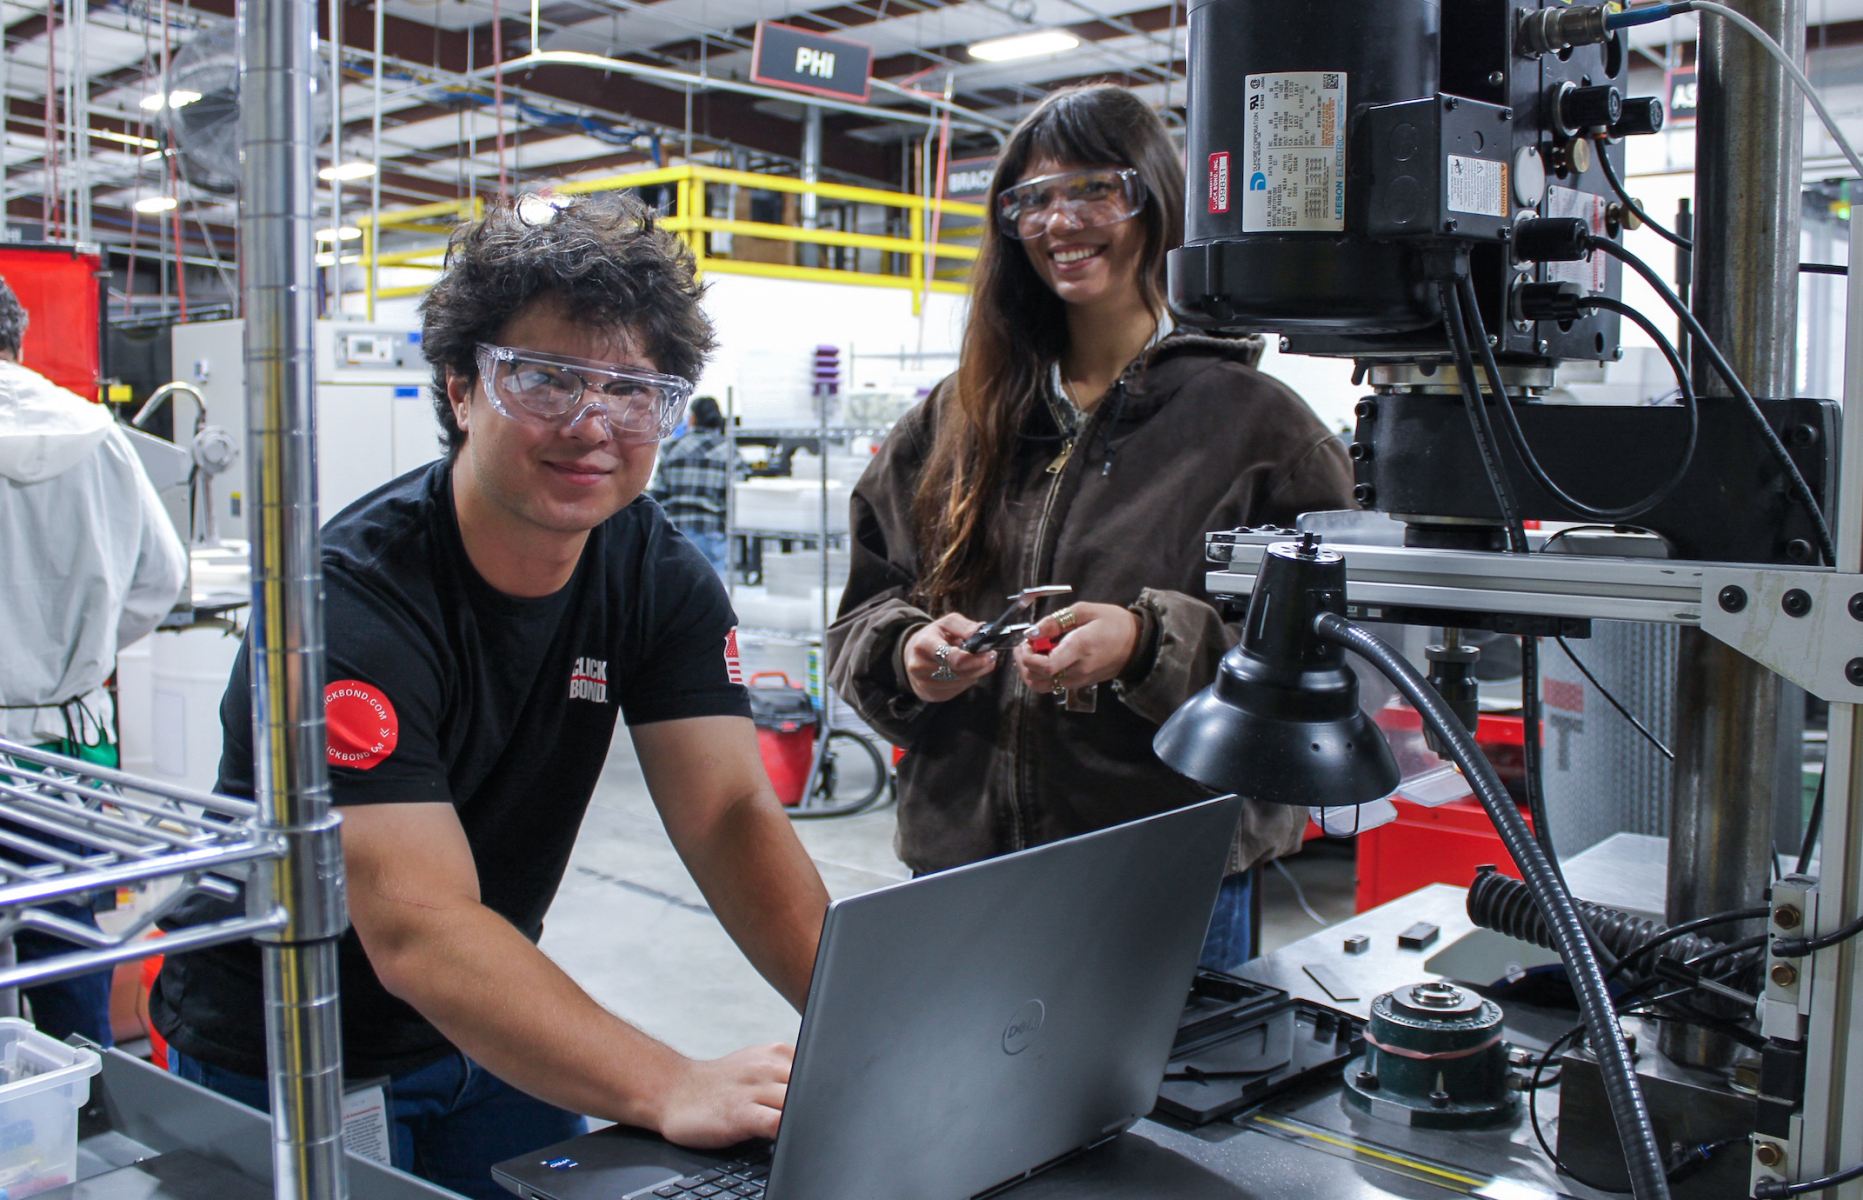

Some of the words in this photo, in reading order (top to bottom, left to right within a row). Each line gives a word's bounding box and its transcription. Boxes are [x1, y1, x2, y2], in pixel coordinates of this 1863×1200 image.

[795, 46, 835, 79] PHI
[1336, 135, 1344, 177] ELECTRIC
[1335, 181, 1343, 220] LEESON
[572, 657, 607, 681] CLICK
